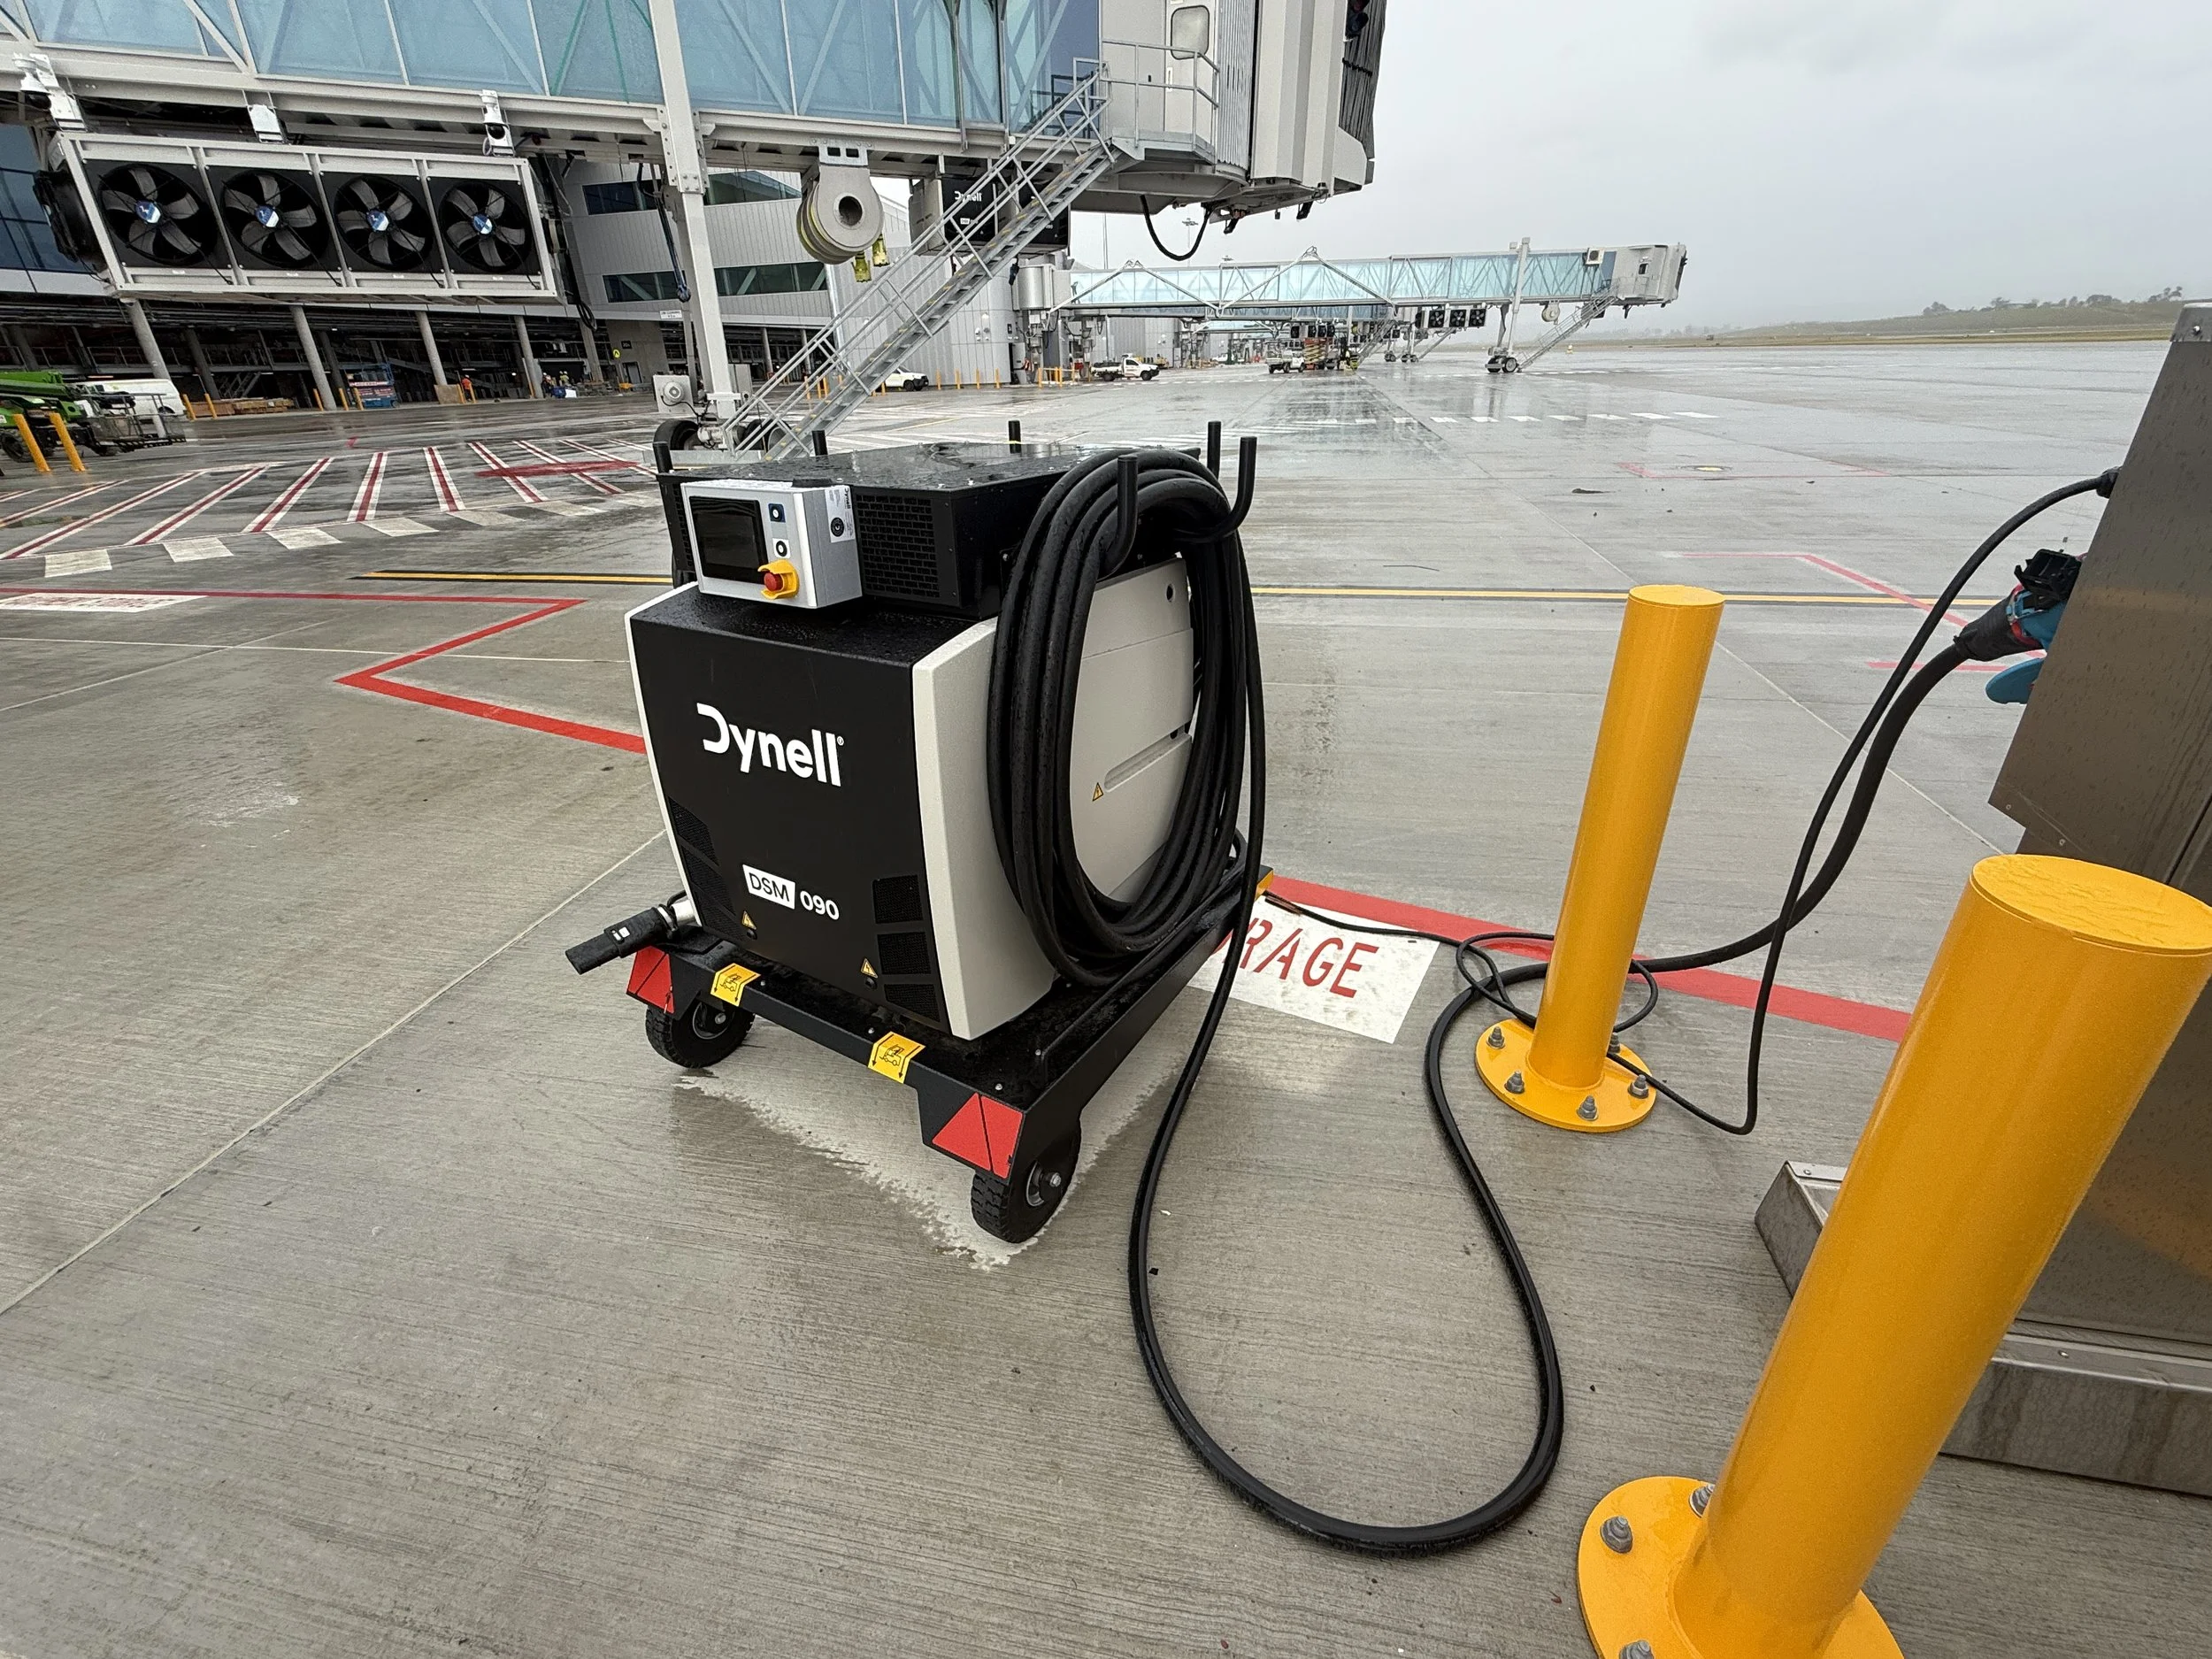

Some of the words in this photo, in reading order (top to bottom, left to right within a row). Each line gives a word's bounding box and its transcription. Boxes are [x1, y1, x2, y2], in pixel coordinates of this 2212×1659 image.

[696, 703, 841, 787] Dynell
[749, 872, 789, 902] DSM
[800, 890, 840, 920] 090
